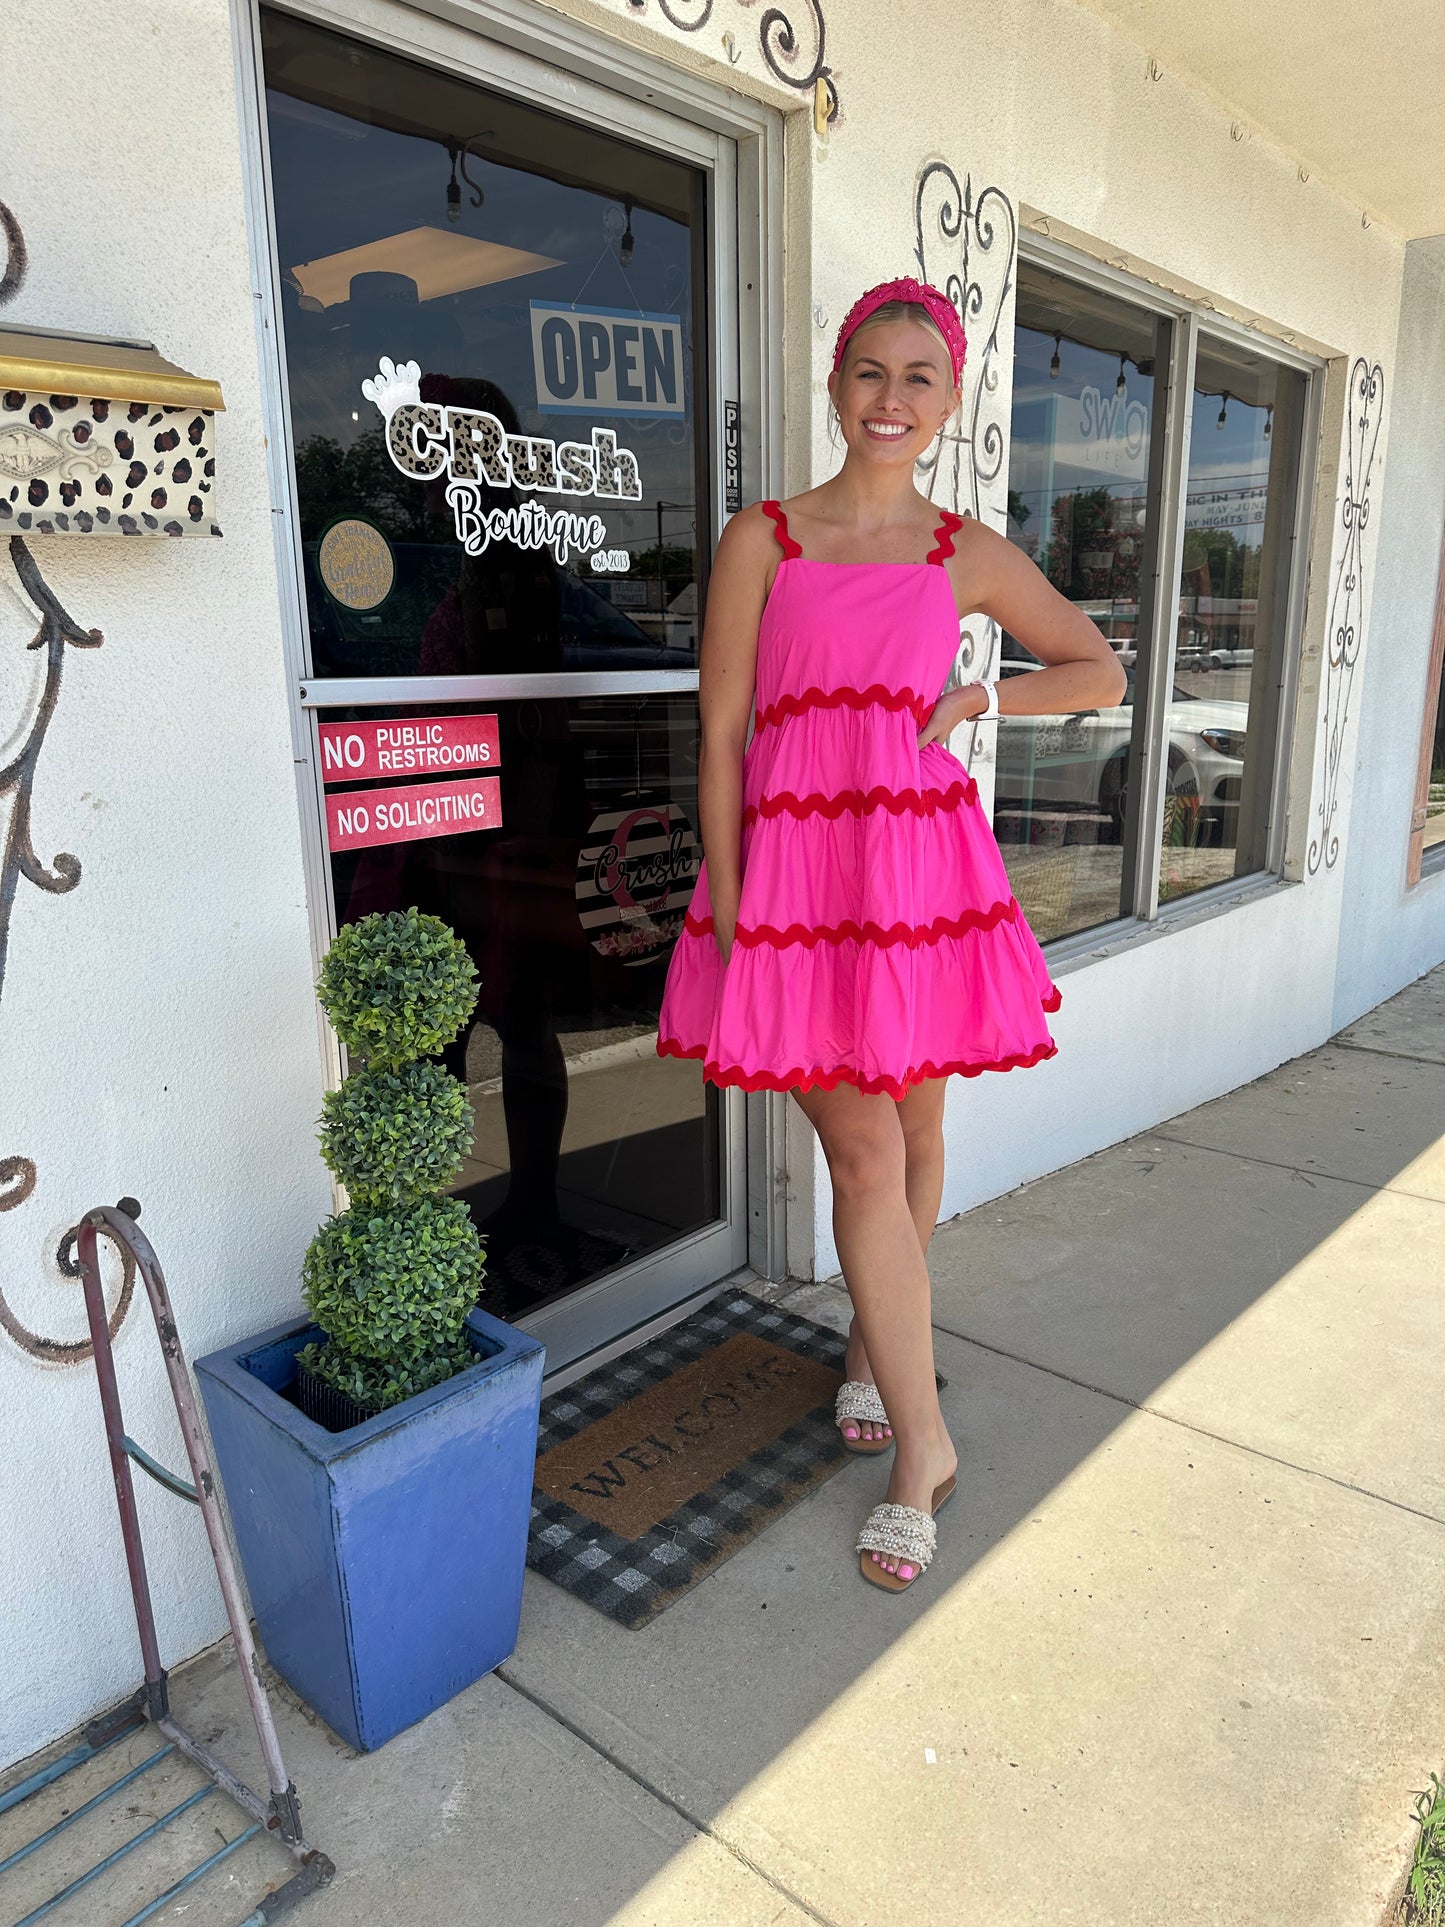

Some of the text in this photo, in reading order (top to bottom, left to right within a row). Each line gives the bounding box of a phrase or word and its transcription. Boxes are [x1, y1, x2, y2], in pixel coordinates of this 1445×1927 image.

[541, 316, 677, 404] OPEN
[726, 408, 738, 487] PUSH
[1186, 496, 1206, 506] SIC
[1211, 494, 1228, 503] IN
[447, 484, 605, 564] Boutique
[1202, 514, 1243, 526] NIGHTS
[608, 553, 629, 569] 2013
[323, 735, 366, 770] NO
[376, 725, 444, 748] PUBLIC
[378, 743, 491, 770] RESTROOMS
[337, 792, 486, 836] NO SOLICITING
[580, 828, 694, 896] Crush
[569, 1356, 802, 1500] WELCOME
